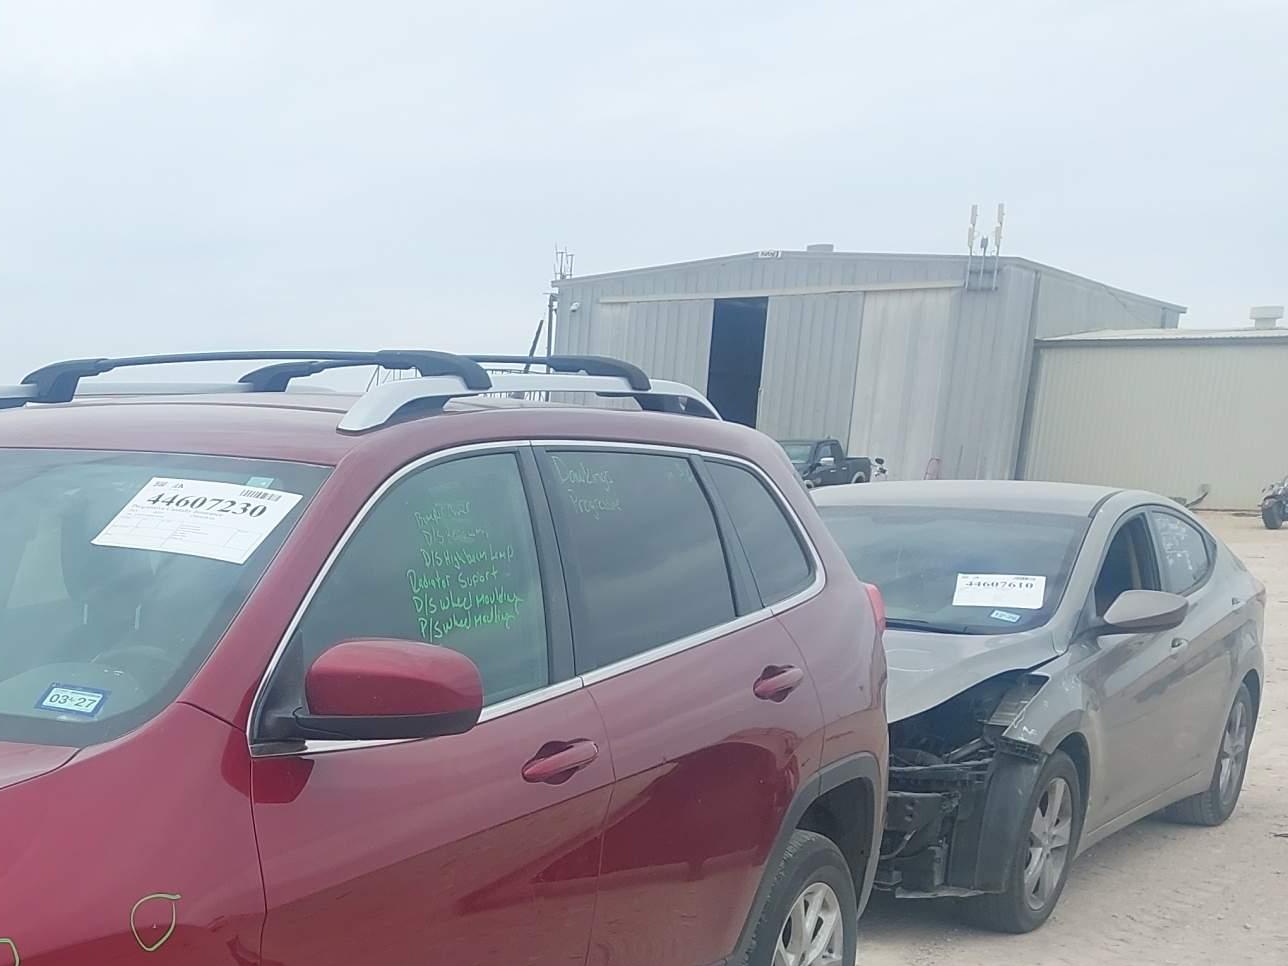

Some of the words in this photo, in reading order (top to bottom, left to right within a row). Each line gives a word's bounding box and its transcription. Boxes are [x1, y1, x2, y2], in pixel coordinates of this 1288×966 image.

[147, 492, 267, 518] 44607230
[420, 547, 443, 568] D/S
[406, 568, 450, 593] Radiator
[457, 564, 499, 588] Suport
[412, 592, 438, 616] D/S
[418, 616, 443, 642] P/S
[49, 694, 70, 705] 03
[73, 697, 97, 708] 27
